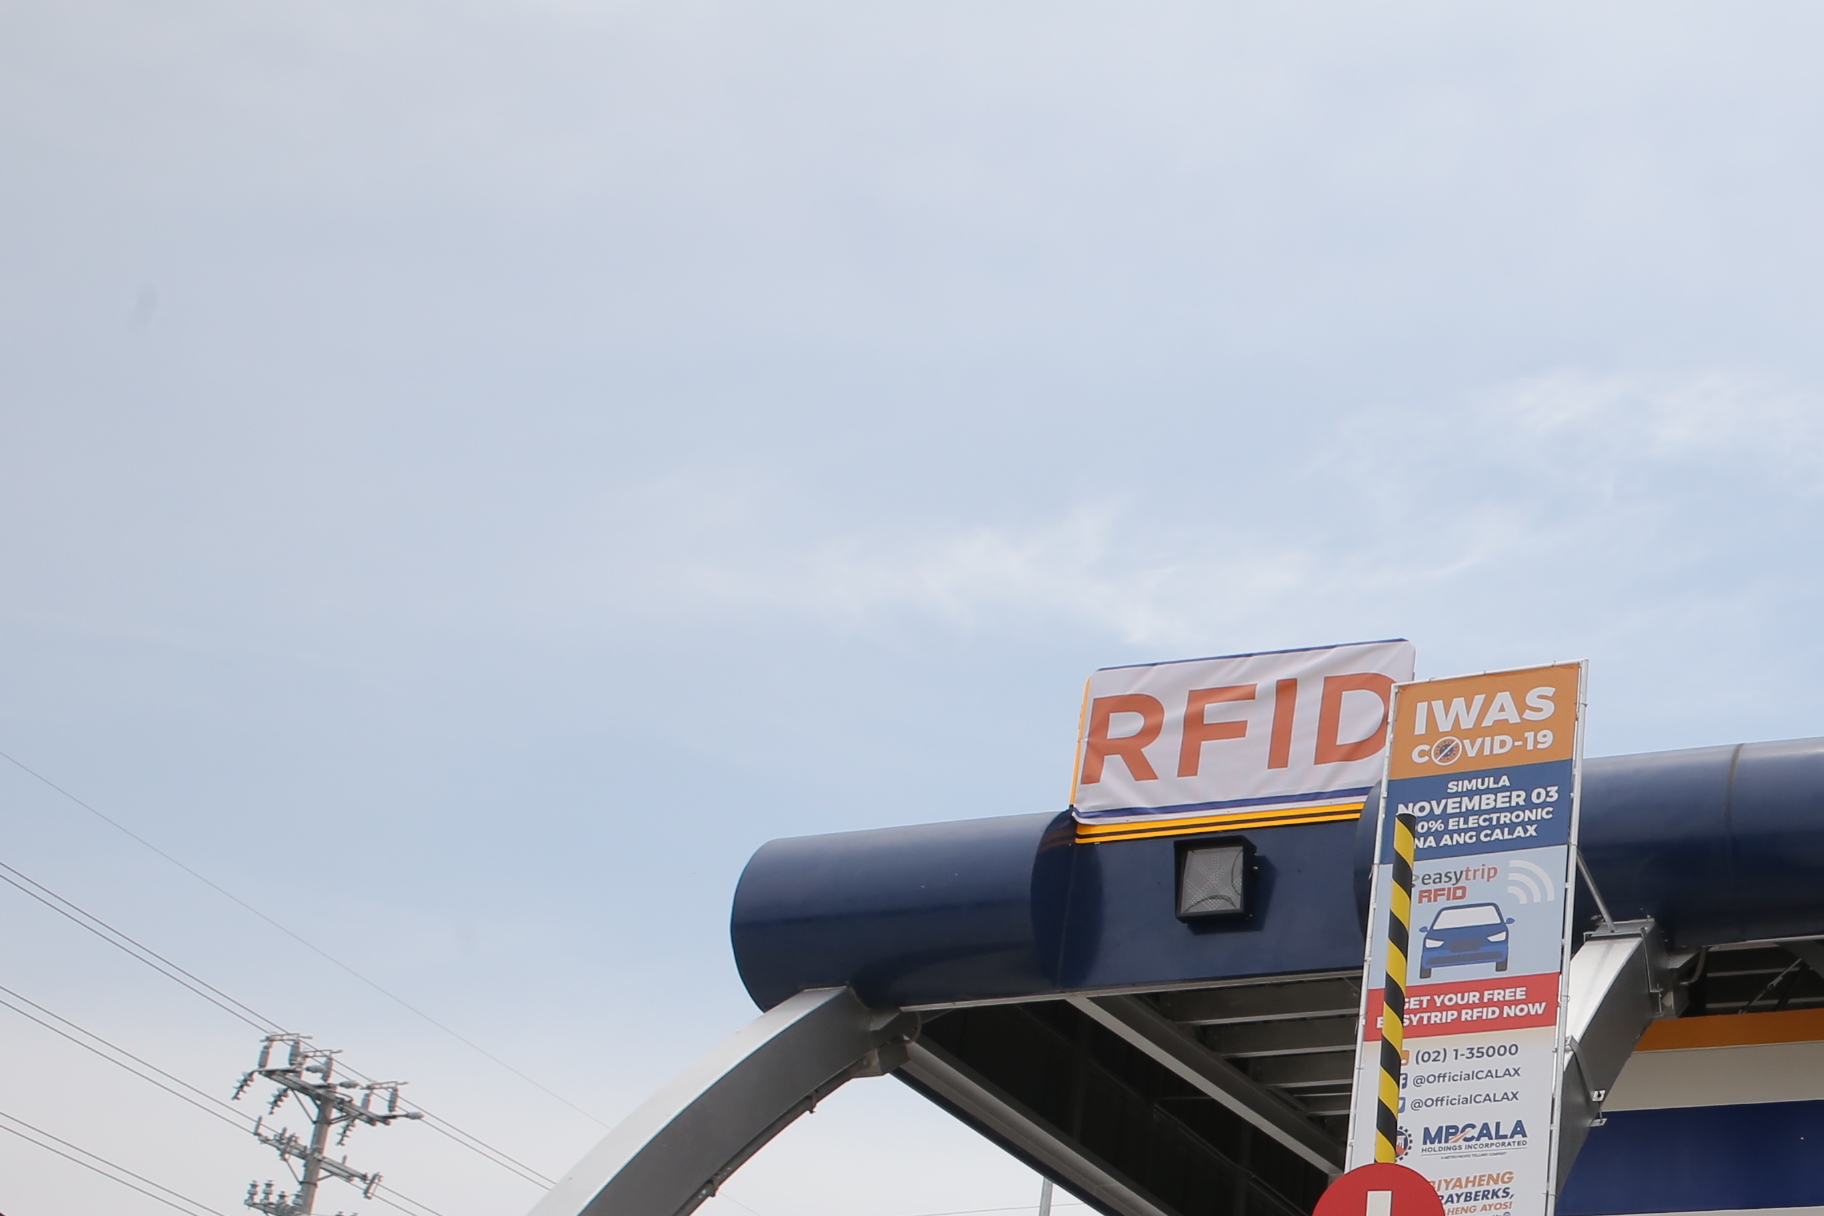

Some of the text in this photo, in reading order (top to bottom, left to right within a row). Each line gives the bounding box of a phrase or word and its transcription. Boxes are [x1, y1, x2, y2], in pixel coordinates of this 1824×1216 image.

[1414, 686, 1556, 736] IWAS
[1080, 672, 1395, 784] RFID
[1411, 729, 1553, 766] COVID-19
[1447, 775, 1510, 793] SIMULA
[1396, 786, 1559, 817] NOVEMBER 03
[1447, 807, 1554, 831] ELECTRONIC
[1439, 832, 1477, 847] ANG
[1479, 824, 1538, 842] CALAX
[1421, 864, 1498, 886] easytrip
[1418, 885, 1467, 904] RFID
[1433, 992, 1480, 1008] YOUR
[1483, 987, 1527, 1003] FREE
[1376, 1002, 1547, 1029] ESYTRIP RFID NOW
[1415, 1043, 1519, 1065] (02) 1-35000
[1412, 1067, 1521, 1088] @OfficialCALAX
[1410, 1091, 1519, 1111] @OfficialCALAX
[1422, 1119, 1528, 1145] MPCALA
[1421, 1139, 1528, 1154] HOLDINGS INCORPORATED
[1438, 1187, 1515, 1206] AYBERKS,
[1480, 1201, 1513, 1213] AYOS!
